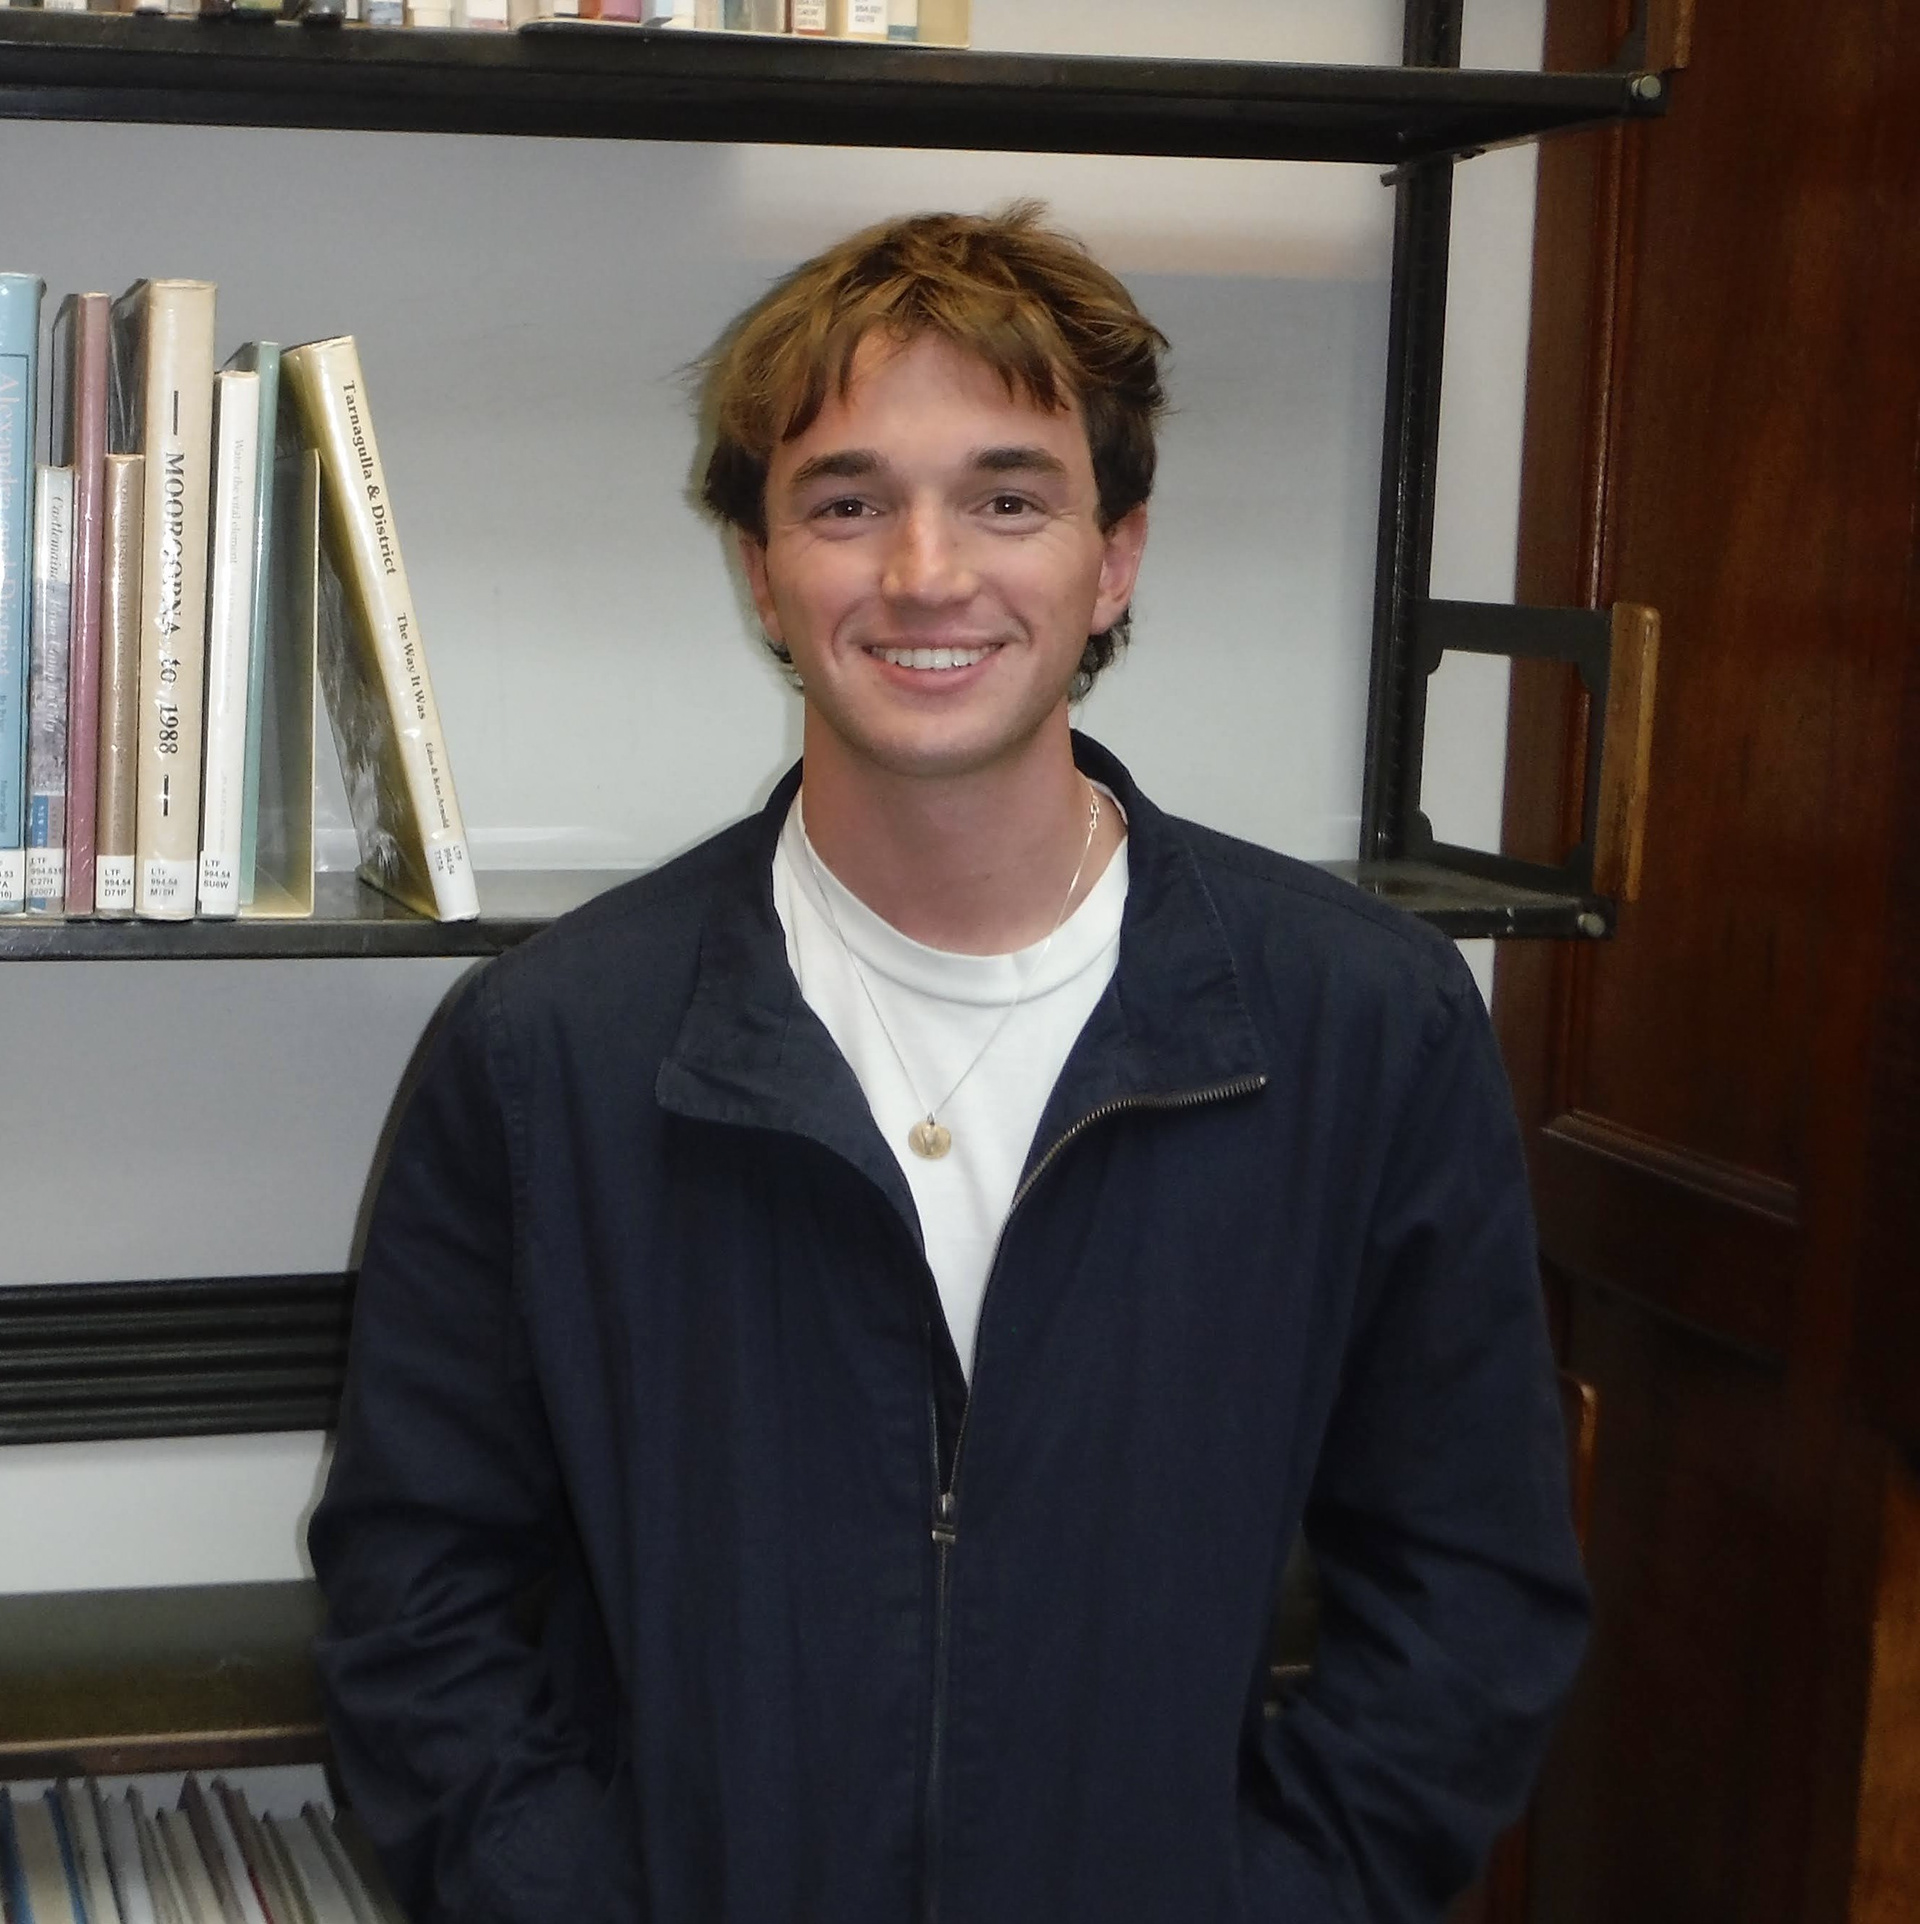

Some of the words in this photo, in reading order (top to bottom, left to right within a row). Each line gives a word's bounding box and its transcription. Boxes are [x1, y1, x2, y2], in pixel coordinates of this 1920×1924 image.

[343, 380, 374, 480] Tarnagulla
[366, 483, 381, 501] &
[50, 496, 64, 582] Castlemaine
[371, 504, 397, 575] District
[397, 612, 408, 640] The
[160, 659, 181, 683] to
[403, 643, 416, 674] Way
[411, 675, 421, 687] It
[414, 689, 426, 720] Was
[159, 704, 179, 754] 1988
[104, 869, 121, 877] LTF
[104, 879, 132, 887] 994.54
[204, 869, 231, 879] 994.54
